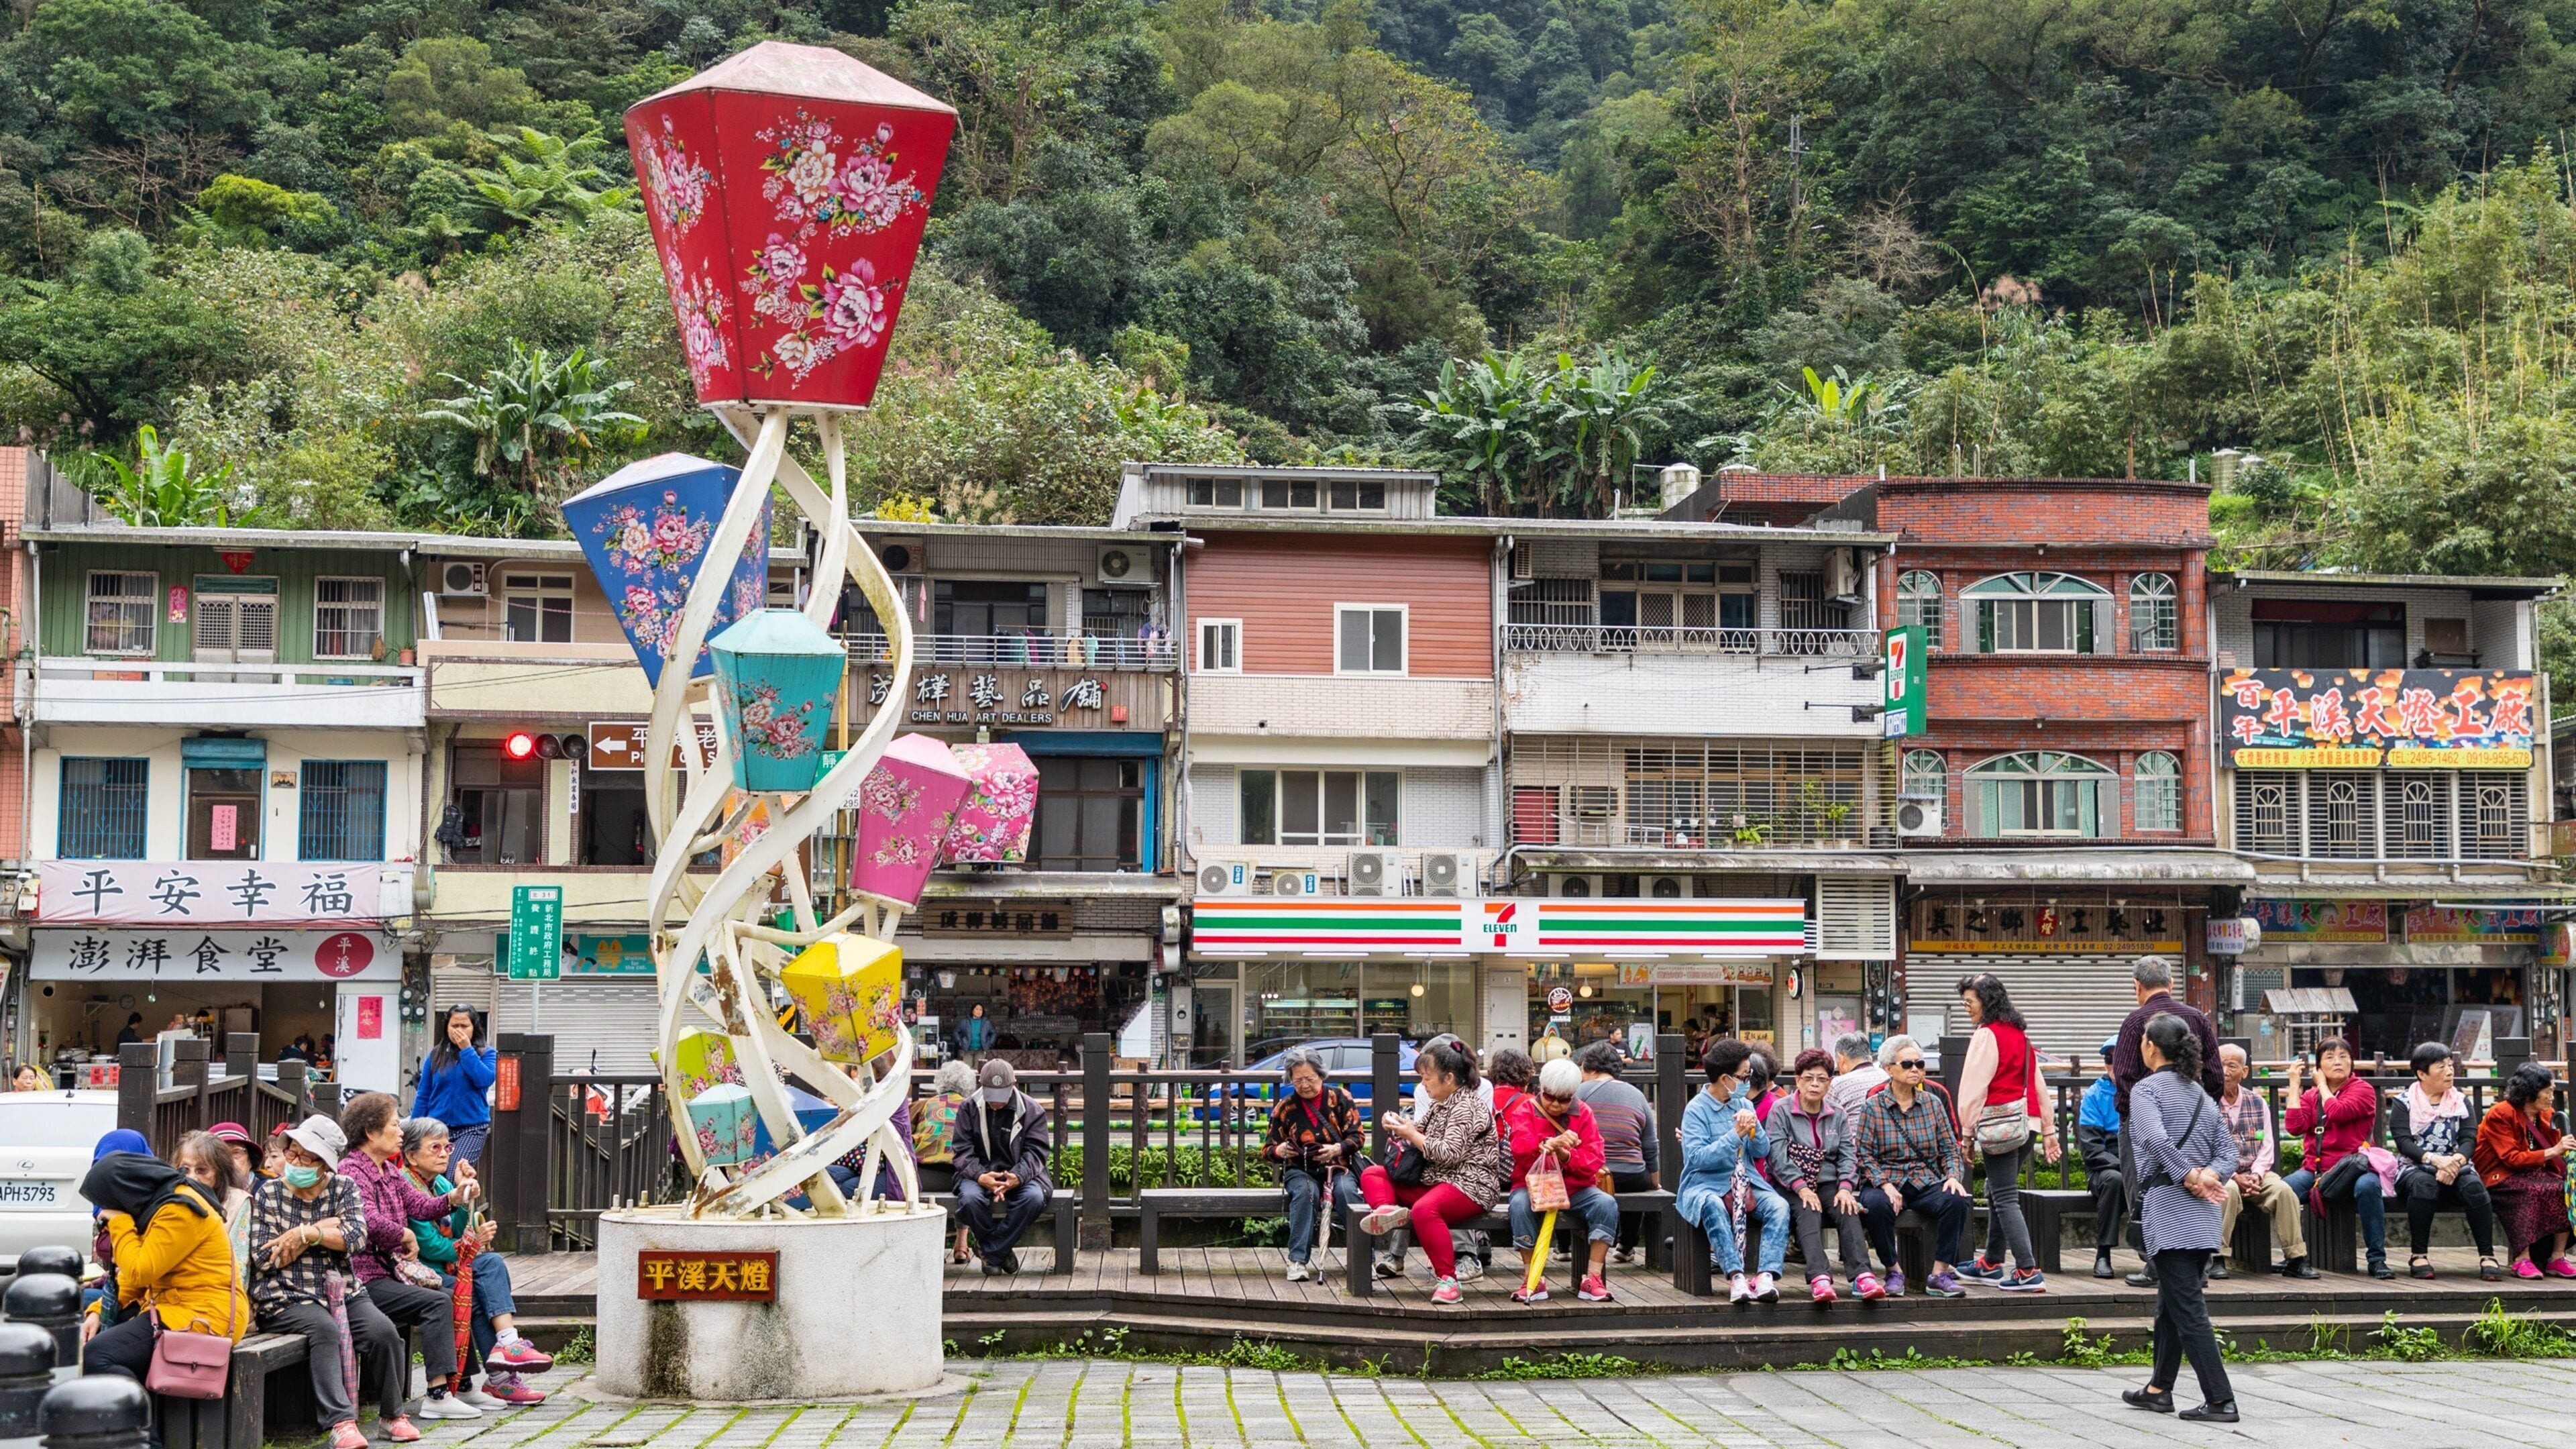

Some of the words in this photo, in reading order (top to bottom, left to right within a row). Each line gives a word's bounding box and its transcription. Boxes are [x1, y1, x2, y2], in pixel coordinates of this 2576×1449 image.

[912, 711, 941, 722] CHEN
[947, 711, 969, 722] HUA
[975, 712, 997, 722] ART
[1002, 712, 1053, 723] DEALERS
[2231, 679, 2264, 743] 百年
[2270, 687, 2531, 737] 平溪天燈工廠
[2466, 751, 2530, 764] 0919-955-678
[71, 869, 354, 918] 平安幸福
[69, 936, 288, 974] 澎湃食堂
[335, 936, 352, 973] 平溪
[542, 904, 553, 977] 新北市政府工務局
[644, 1258, 771, 1292] 平溪天燈
